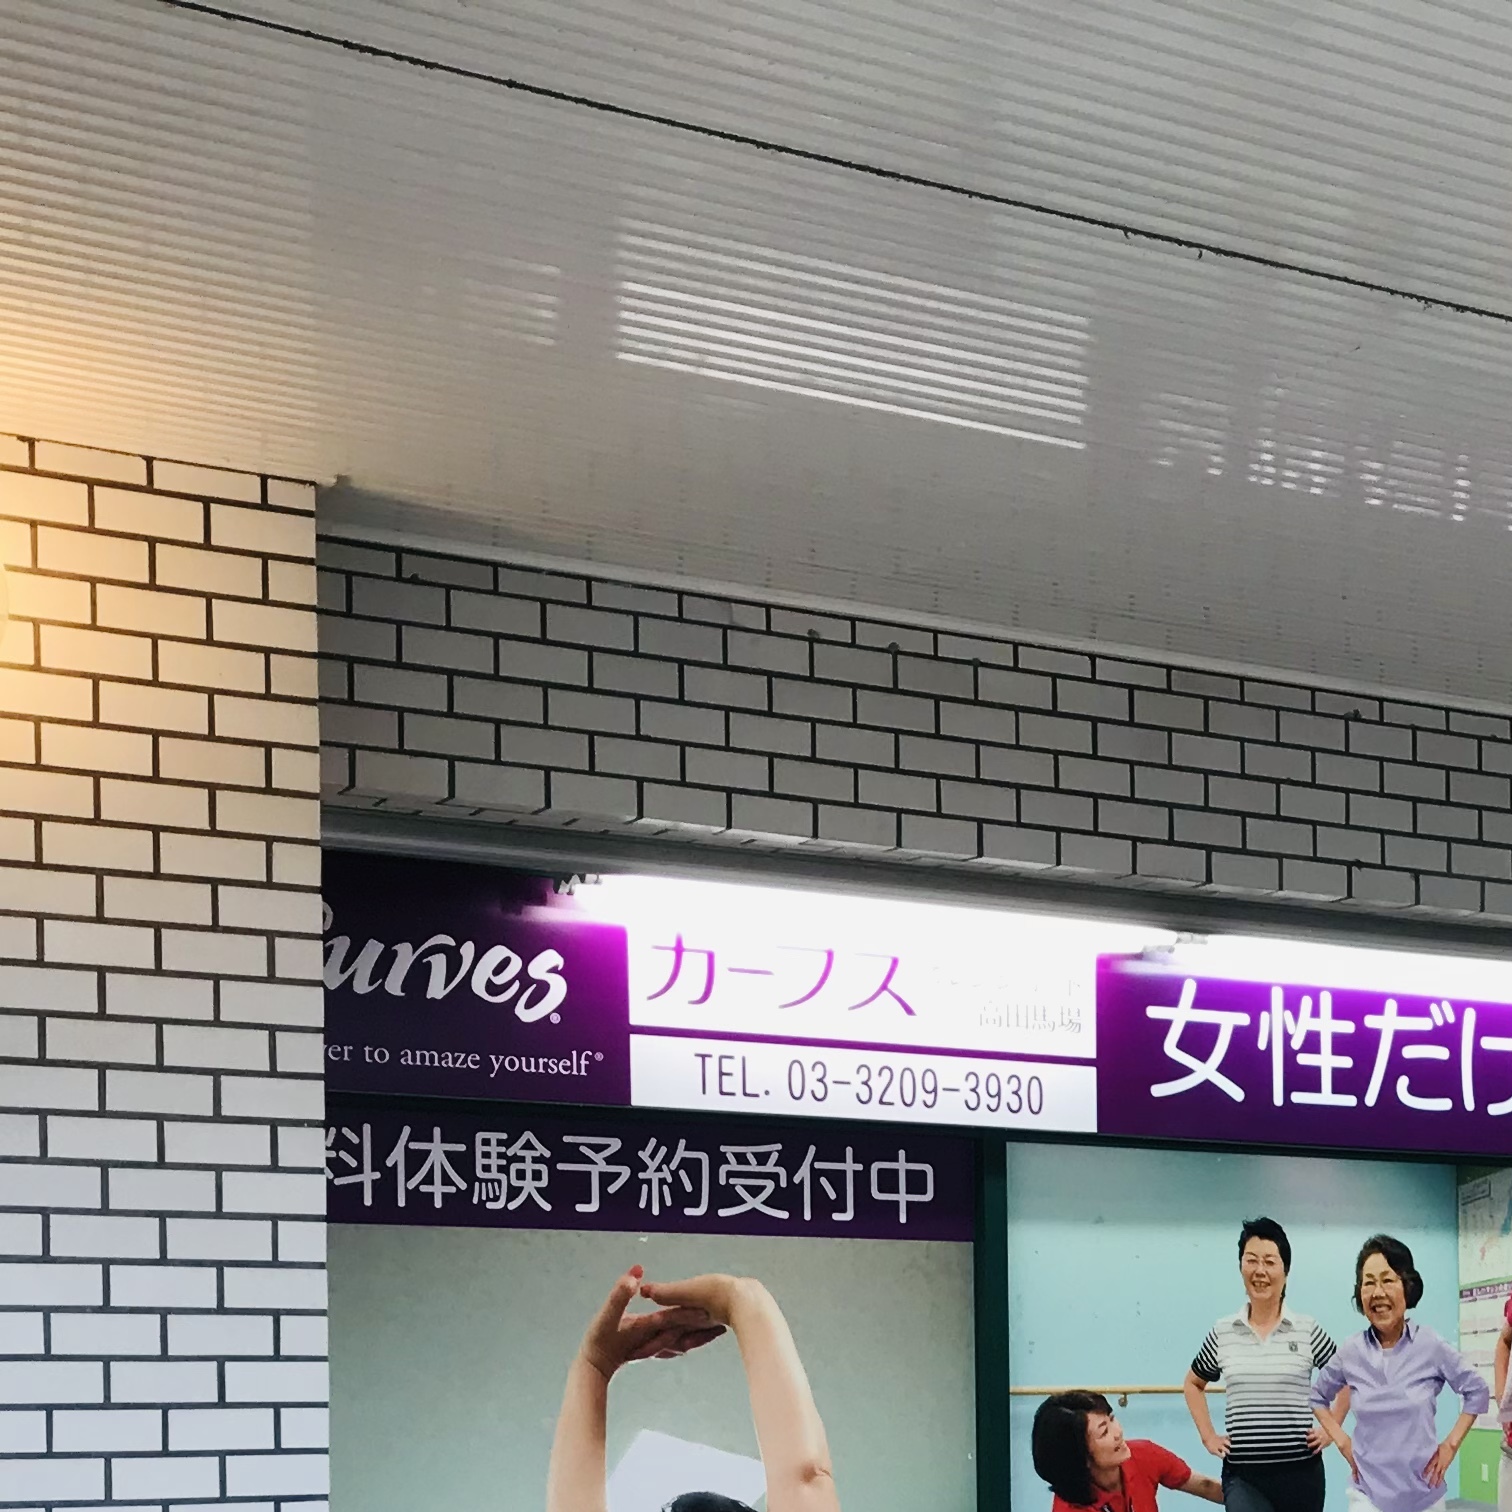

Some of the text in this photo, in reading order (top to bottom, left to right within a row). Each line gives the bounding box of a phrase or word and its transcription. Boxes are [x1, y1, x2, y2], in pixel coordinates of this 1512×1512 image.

[323, 900, 568, 1023] urves
[363, 1047, 390, 1064] to
[400, 1047, 481, 1070] amaze
[694, 1053, 1044, 1115] TEL. 03-3209-3930
